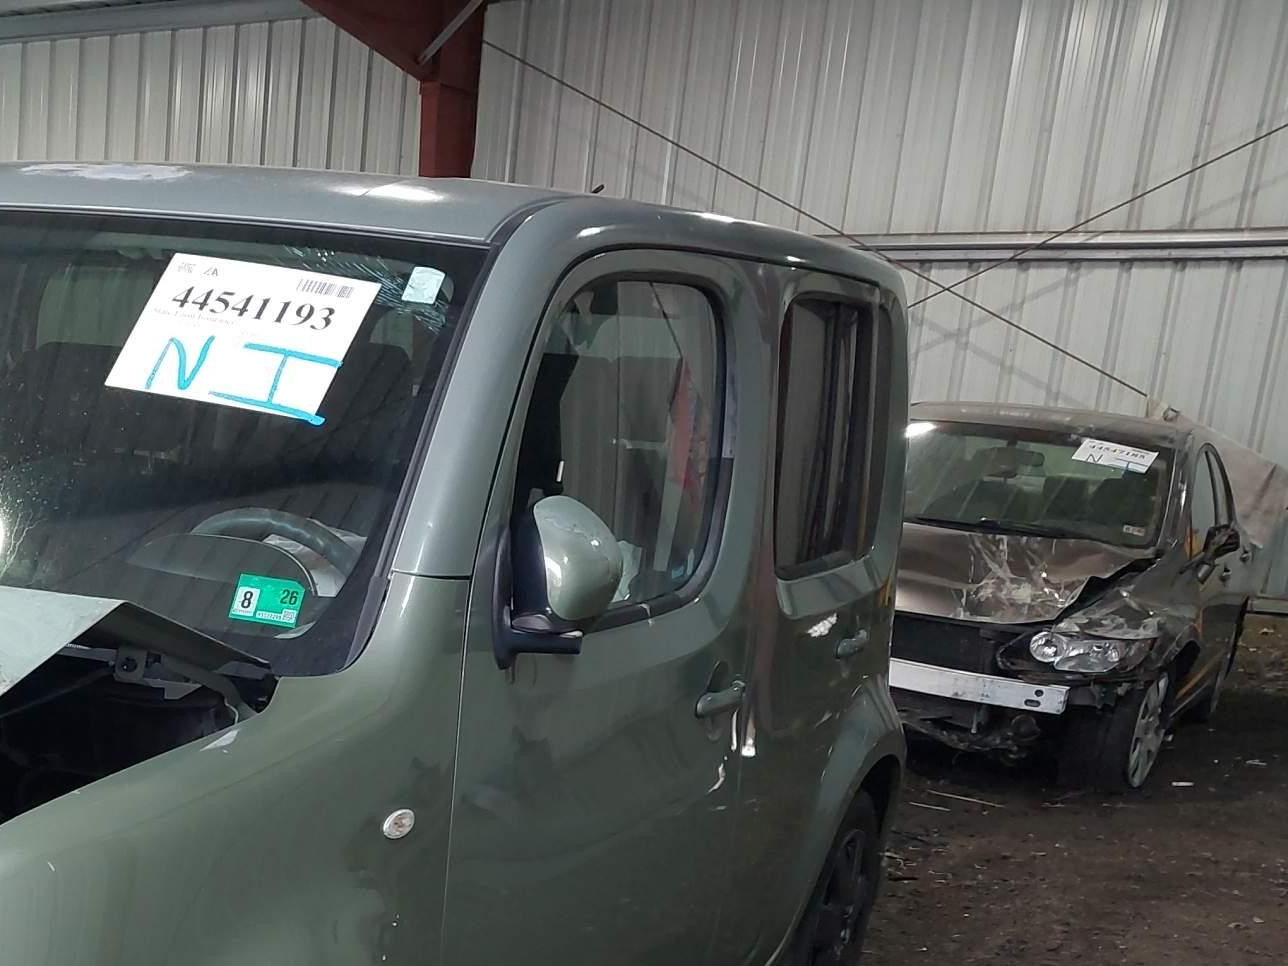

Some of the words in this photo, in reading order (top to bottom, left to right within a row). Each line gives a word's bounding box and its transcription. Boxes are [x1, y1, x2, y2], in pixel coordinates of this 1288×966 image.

[171, 286, 336, 331] 44541193
[145, 335, 216, 391] N
[208, 342, 344, 426] I
[240, 590, 254, 609] 8
[279, 588, 299, 606] 26
